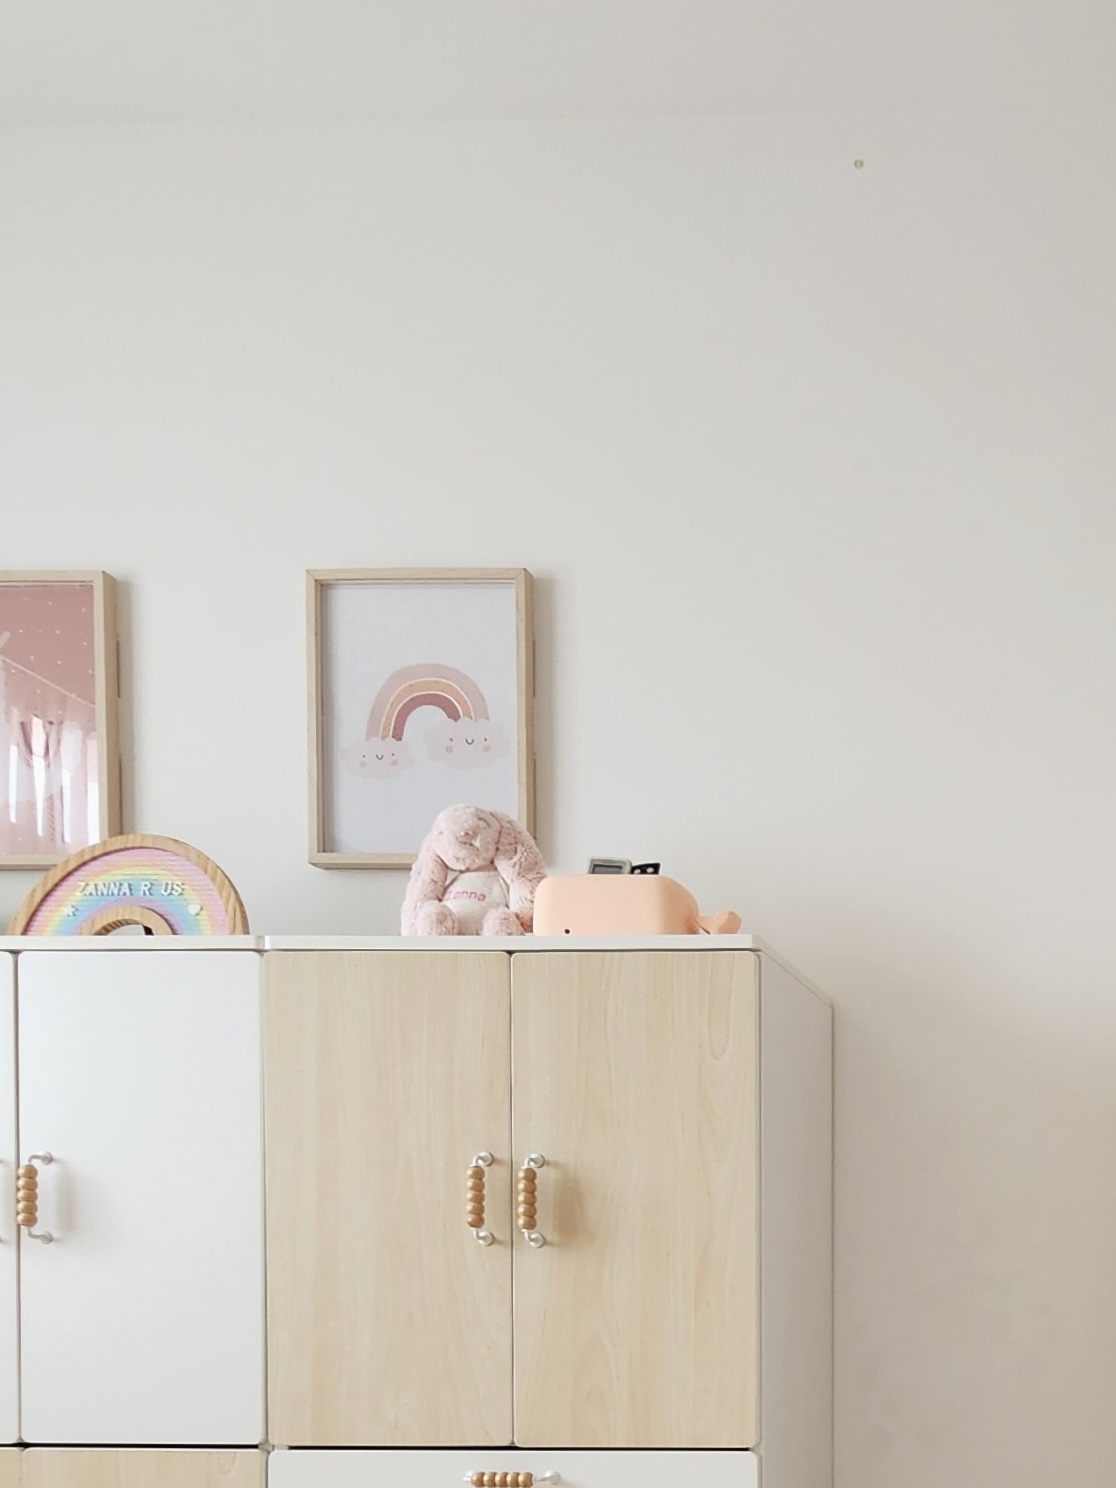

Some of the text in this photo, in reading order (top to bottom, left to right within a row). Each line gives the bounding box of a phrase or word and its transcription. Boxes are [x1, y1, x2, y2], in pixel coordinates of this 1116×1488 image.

[76, 880, 183, 896] ZANNA R US
